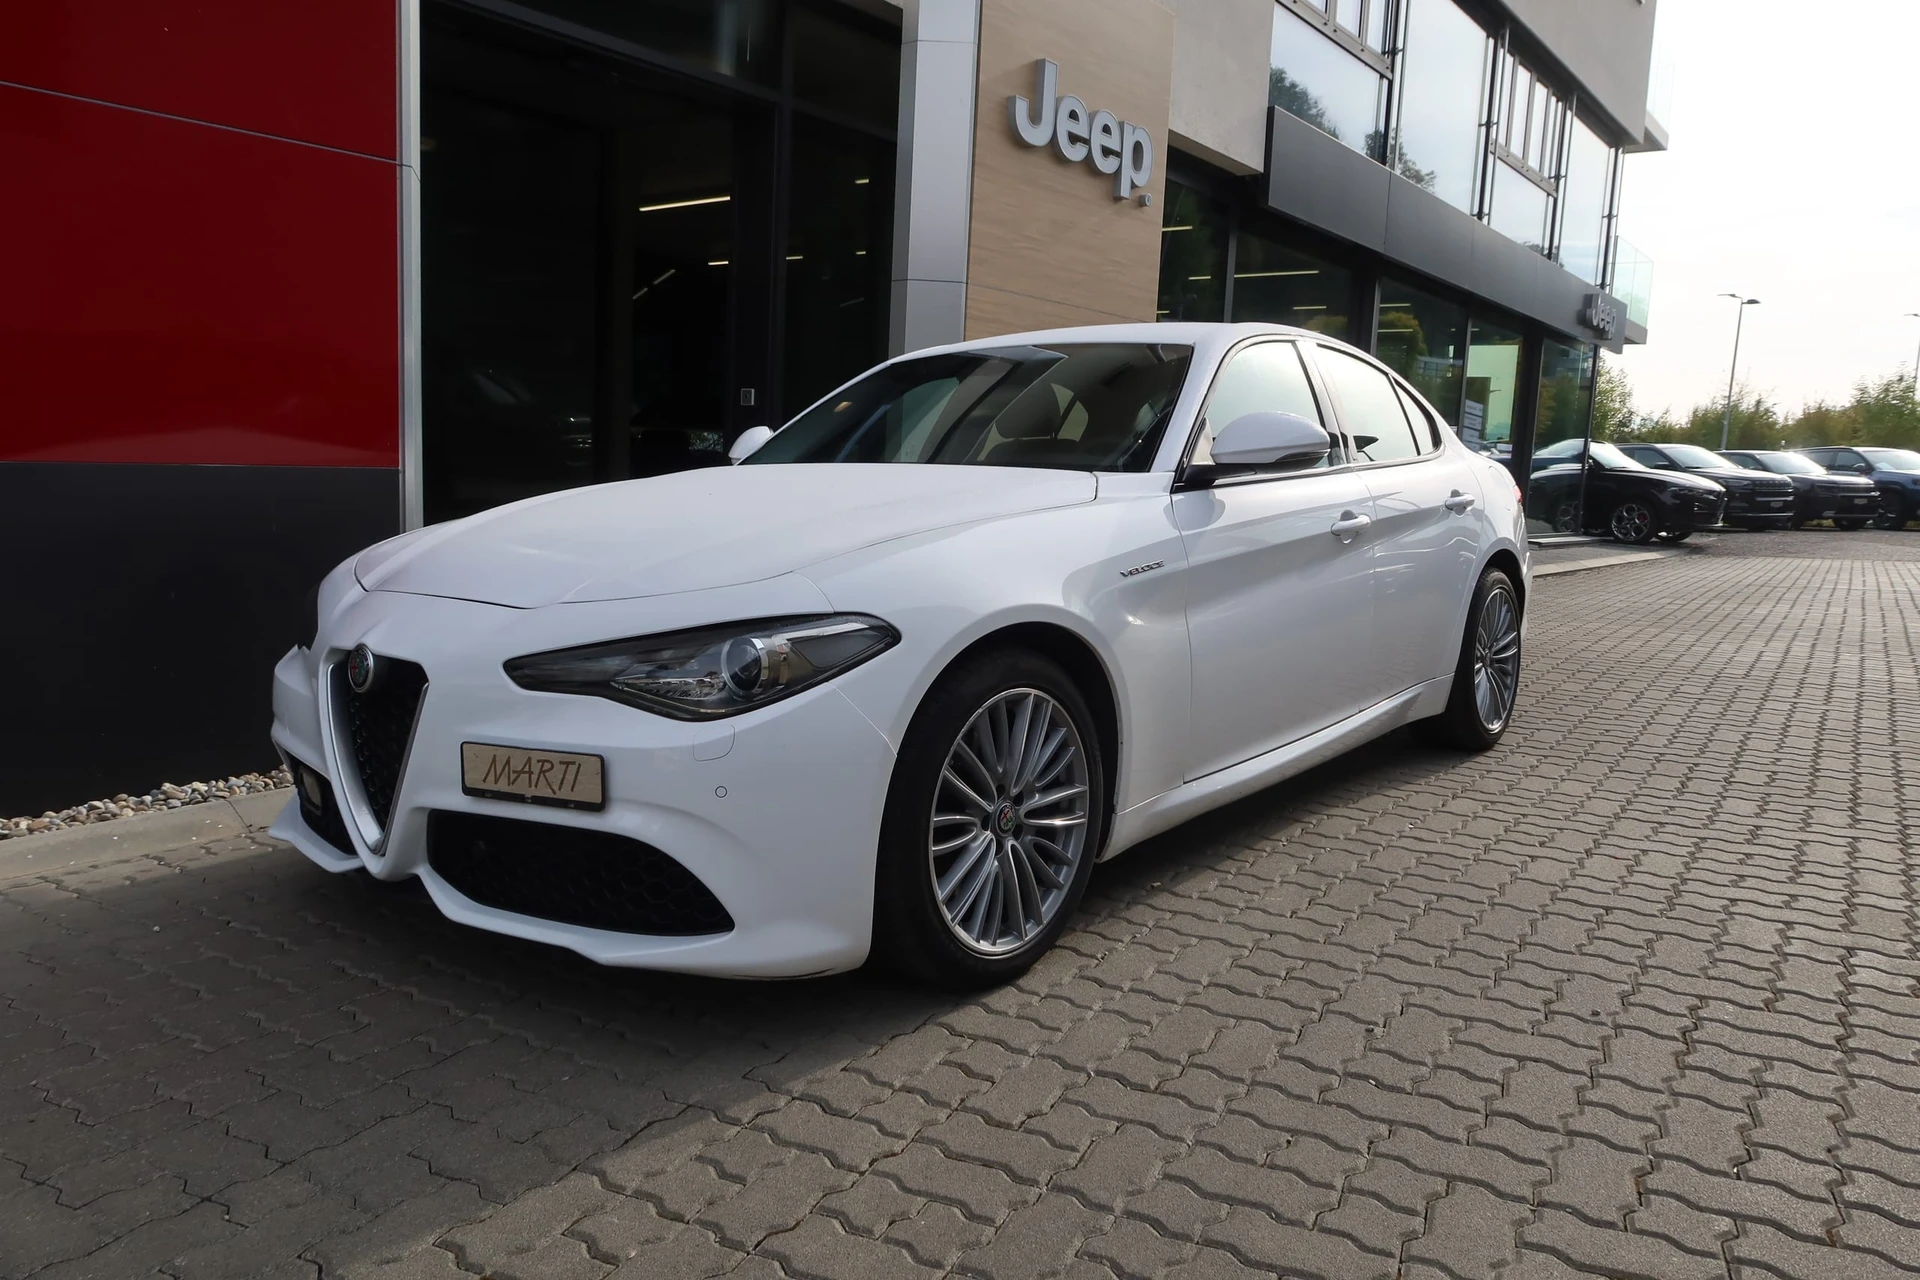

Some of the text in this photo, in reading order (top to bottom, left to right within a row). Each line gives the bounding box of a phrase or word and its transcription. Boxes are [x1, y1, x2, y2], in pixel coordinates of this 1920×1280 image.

[1007, 58, 1153, 200] Jeep
[1587, 294, 1616, 340] Jeep
[1119, 559, 1165, 577] VELOCE
[482, 754, 582, 795] MARTI
